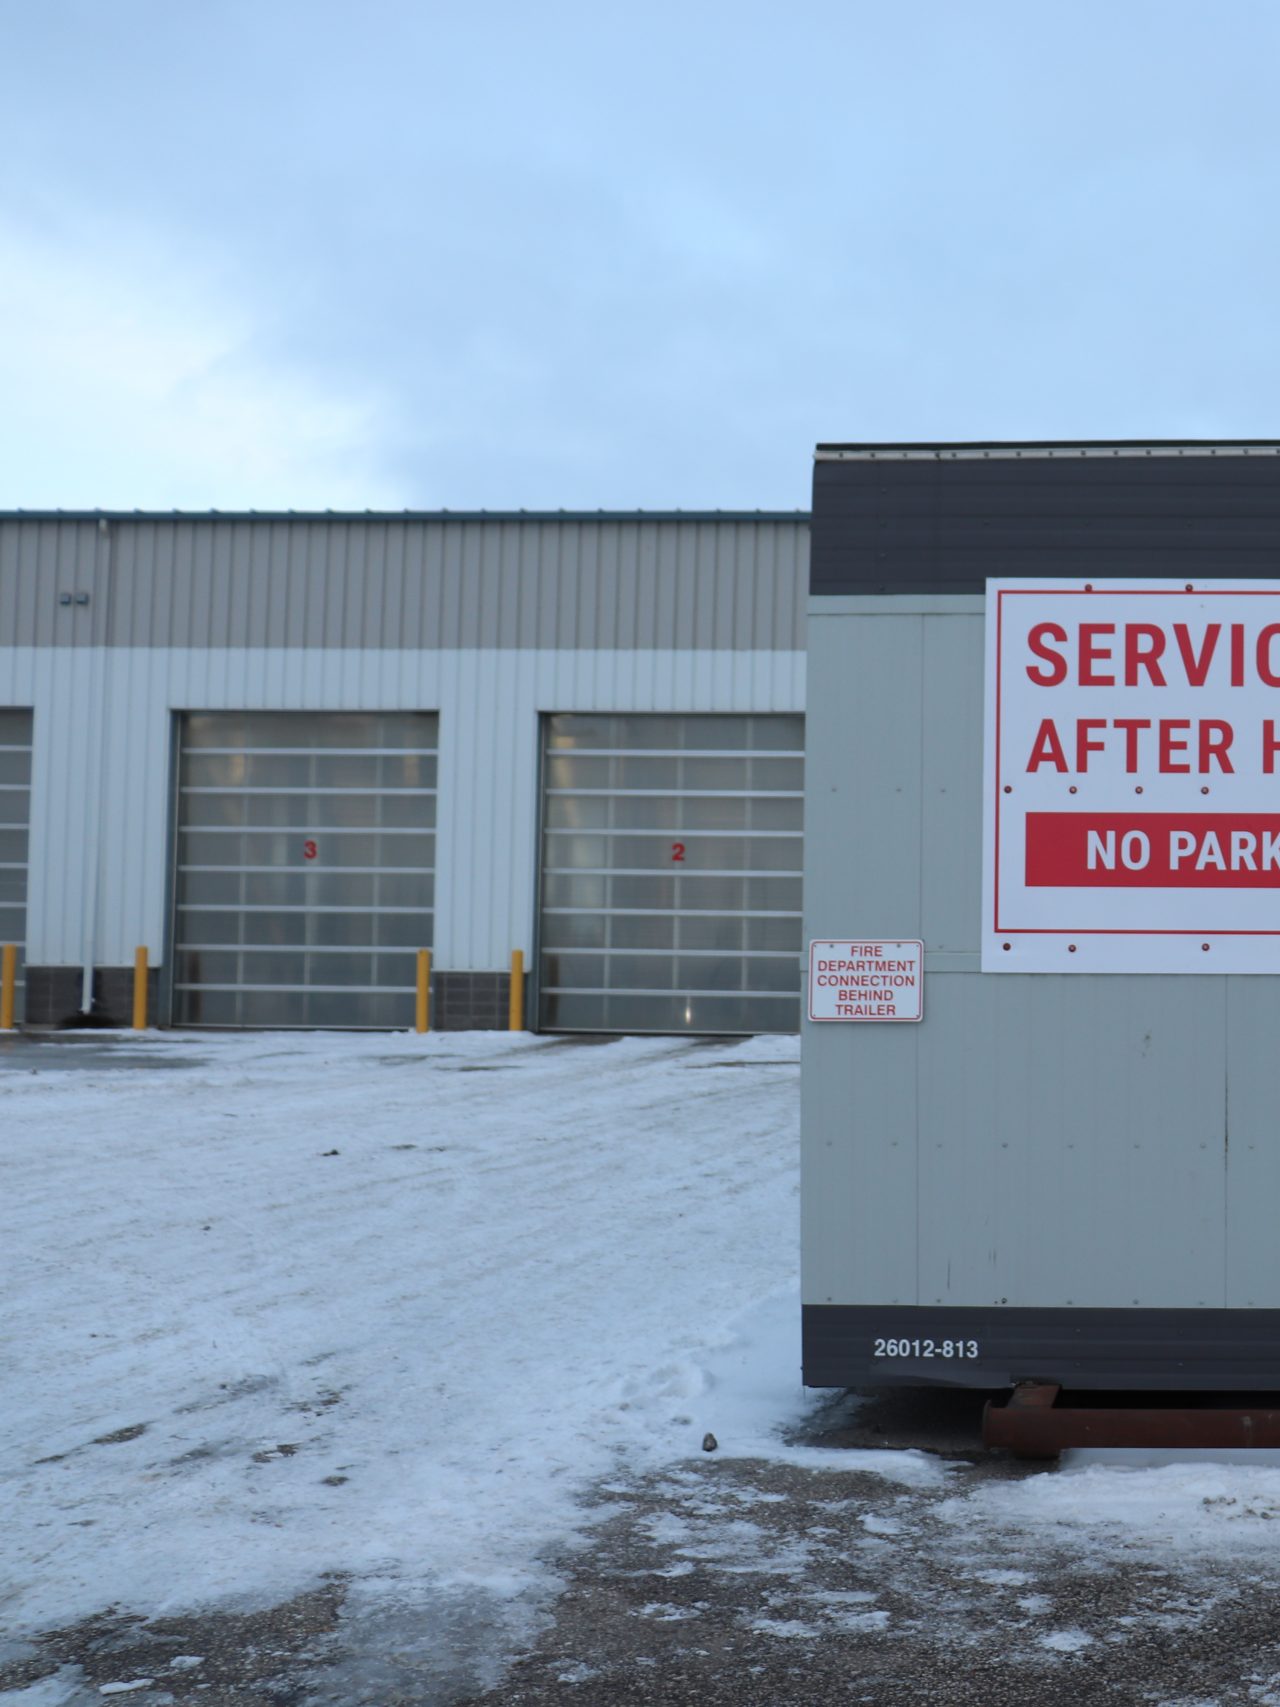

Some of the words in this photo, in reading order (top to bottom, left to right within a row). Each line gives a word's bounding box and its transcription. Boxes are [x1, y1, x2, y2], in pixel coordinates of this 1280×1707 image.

[1026, 718, 1234, 774] AFTER
[304, 840, 317, 859] 3
[671, 842, 685, 861] 2
[1086, 830, 1151, 870] NO
[851, 946, 883, 957] FIRE
[818, 960, 915, 971] DEPARTMENT
[817, 975, 915, 986] CONNECTION
[838, 990, 893, 1001] BEHIND
[835, 1005, 896, 1015] TRAILER
[874, 1338, 979, 1359] 26012-813
